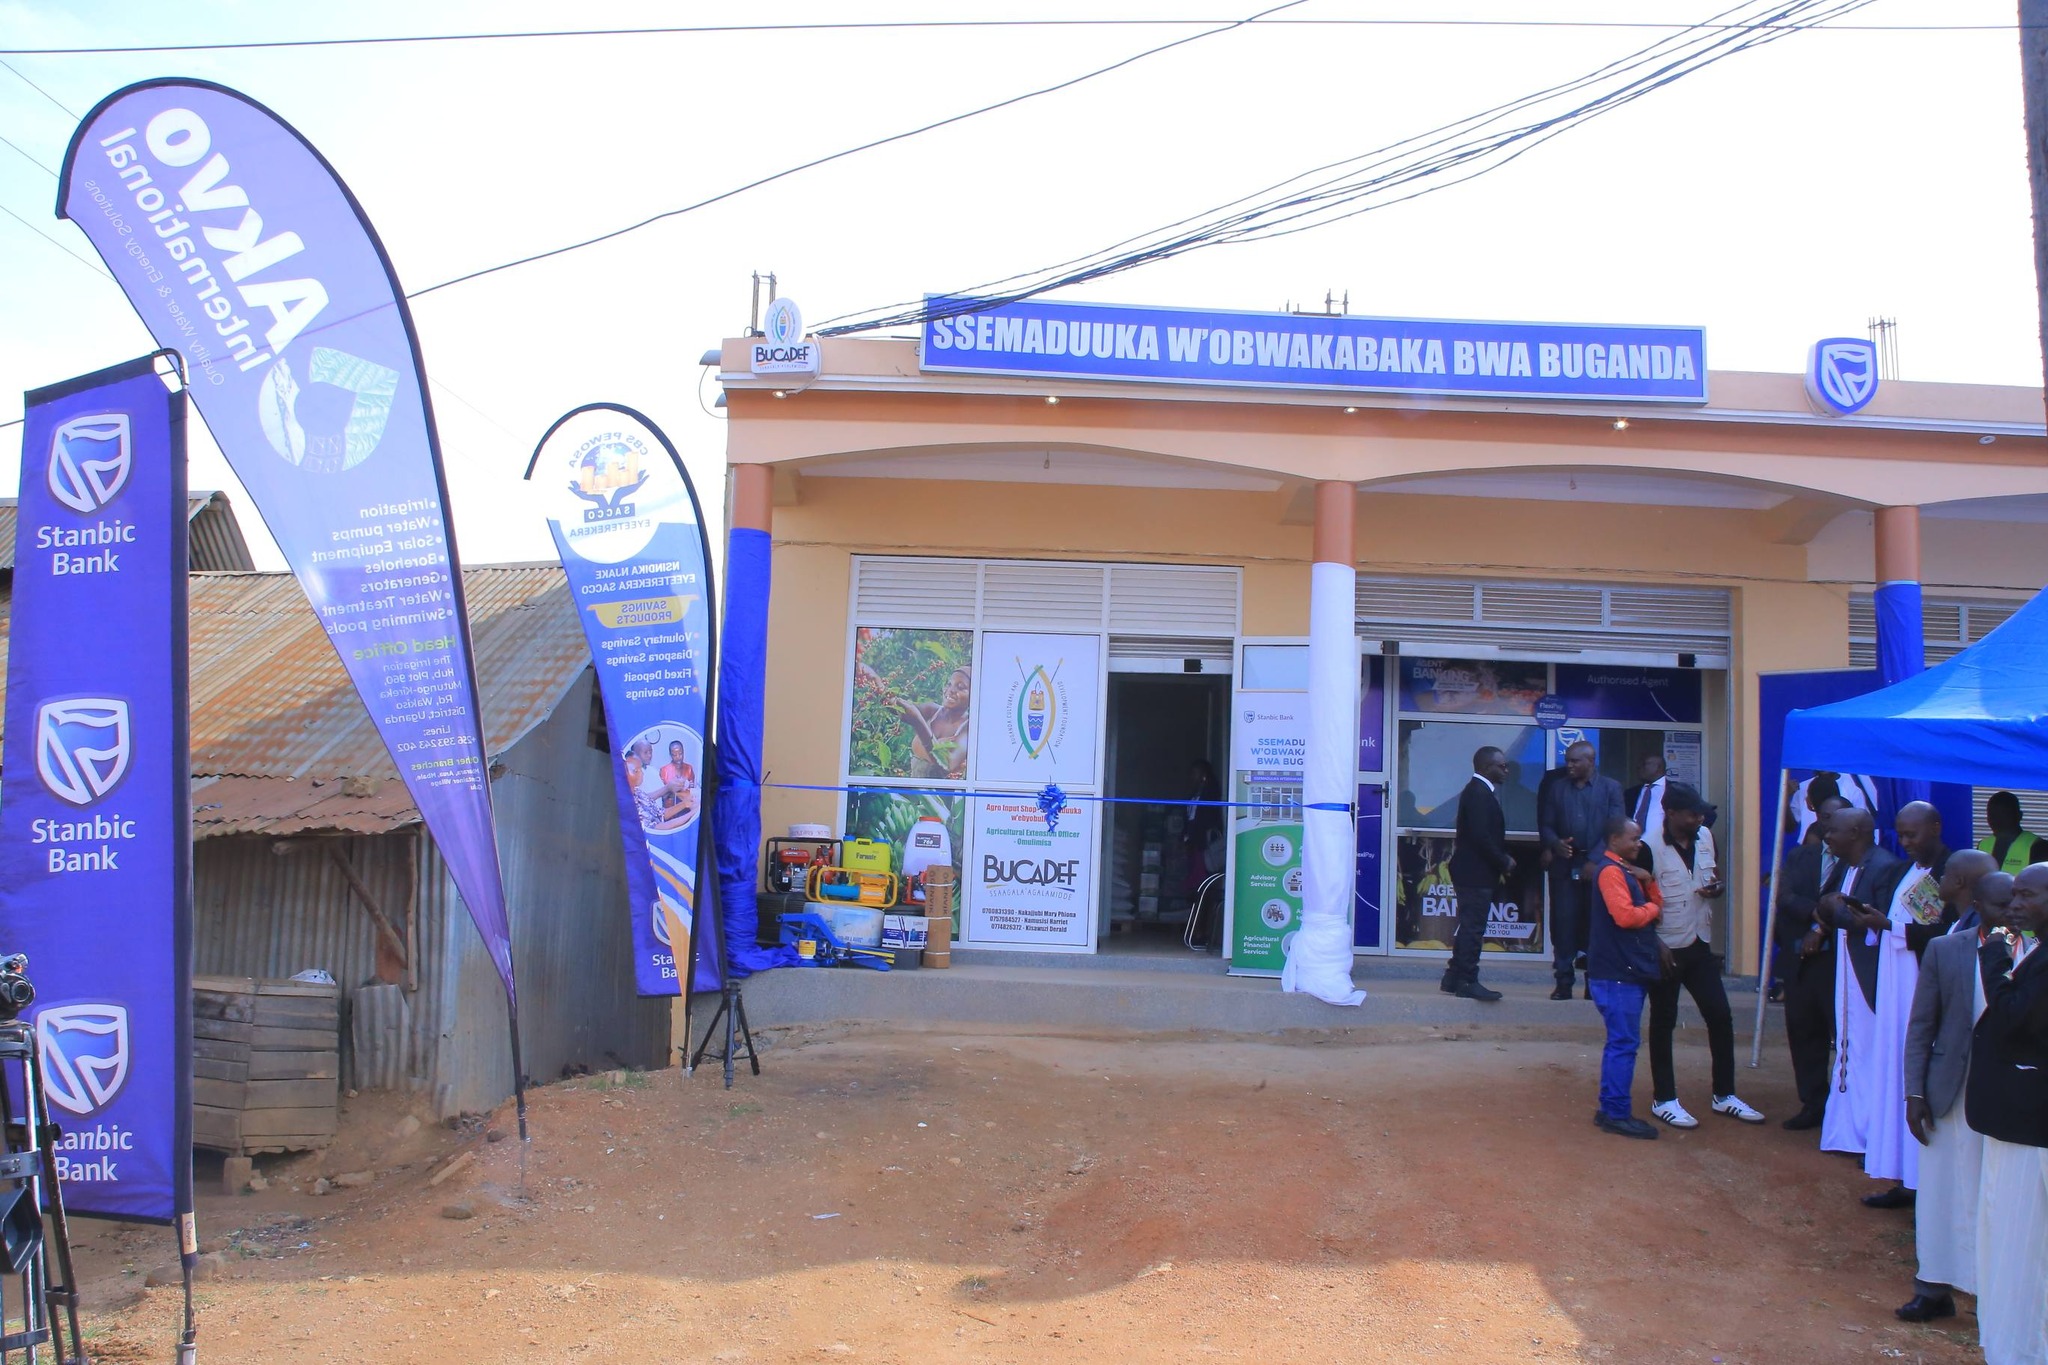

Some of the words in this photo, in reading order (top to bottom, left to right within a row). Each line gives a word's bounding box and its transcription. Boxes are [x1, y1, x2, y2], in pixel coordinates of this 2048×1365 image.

[755, 346, 810, 362] BUCADEF
[932, 314, 1160, 361] SSEMADUUKA
[1167, 327, 1446, 375] W'OBWAKABAKA
[1453, 340, 1532, 377] BWA
[1538, 343, 1696, 381] BUGANDA
[36, 520, 136, 549] Stanbic
[53, 549, 120, 576] Bank
[1587, 674, 1639, 685] Authorised
[1641, 676, 1669, 688] Agent
[1258, 738, 1306, 746] SSEMADU
[1257, 757, 1280, 765] BWA
[1283, 758, 1304, 766] BUG
[1002, 804, 1020, 812] Input
[31, 814, 136, 844] Stanbic
[986, 827, 1025, 836] Agricultural
[1026, 829, 1057, 837] Extension
[1058, 830, 1080, 838] Officer
[49, 845, 119, 873] Bank
[983, 854, 1080, 886] BUCADEF
[1250, 874, 1278, 882] Advisory
[1427, 884, 1457, 896] AGE
[53, 1124, 133, 1151] anbic
[55, 1155, 119, 1182] Bank
